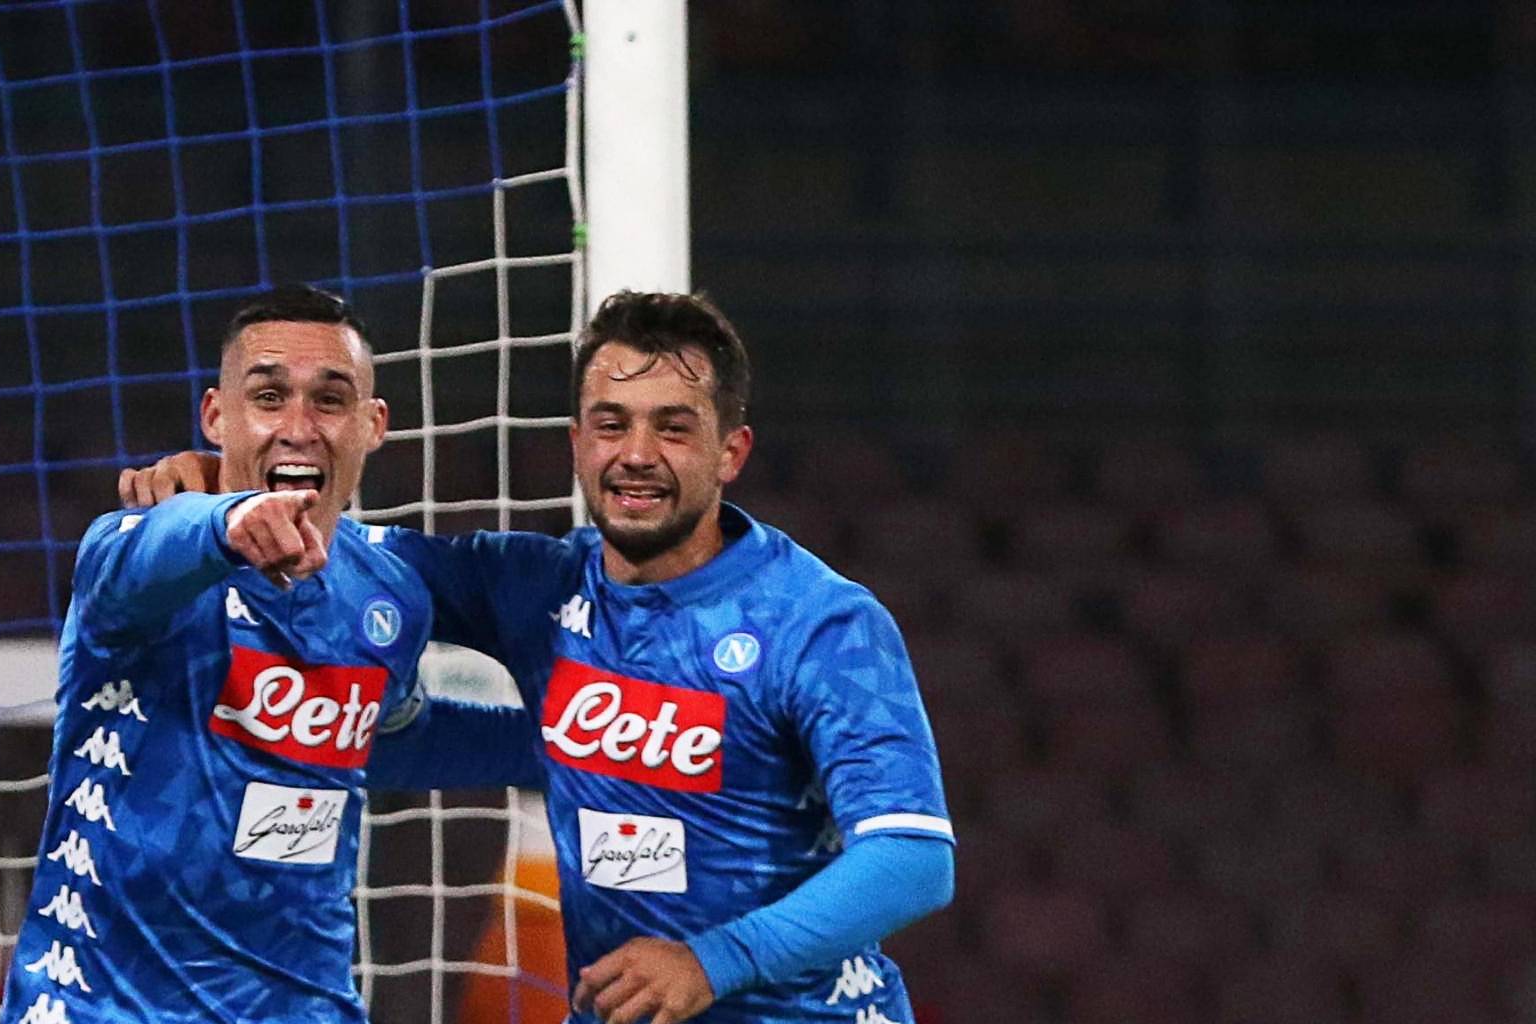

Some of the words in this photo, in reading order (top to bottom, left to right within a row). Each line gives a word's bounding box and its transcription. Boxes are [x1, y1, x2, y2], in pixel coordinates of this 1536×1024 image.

[371, 609, 393, 638] N
[720, 639, 751, 666] N
[213, 665, 380, 751] Lete
[541, 681, 723, 776] Lete
[583, 827, 686, 886] Garofalo
